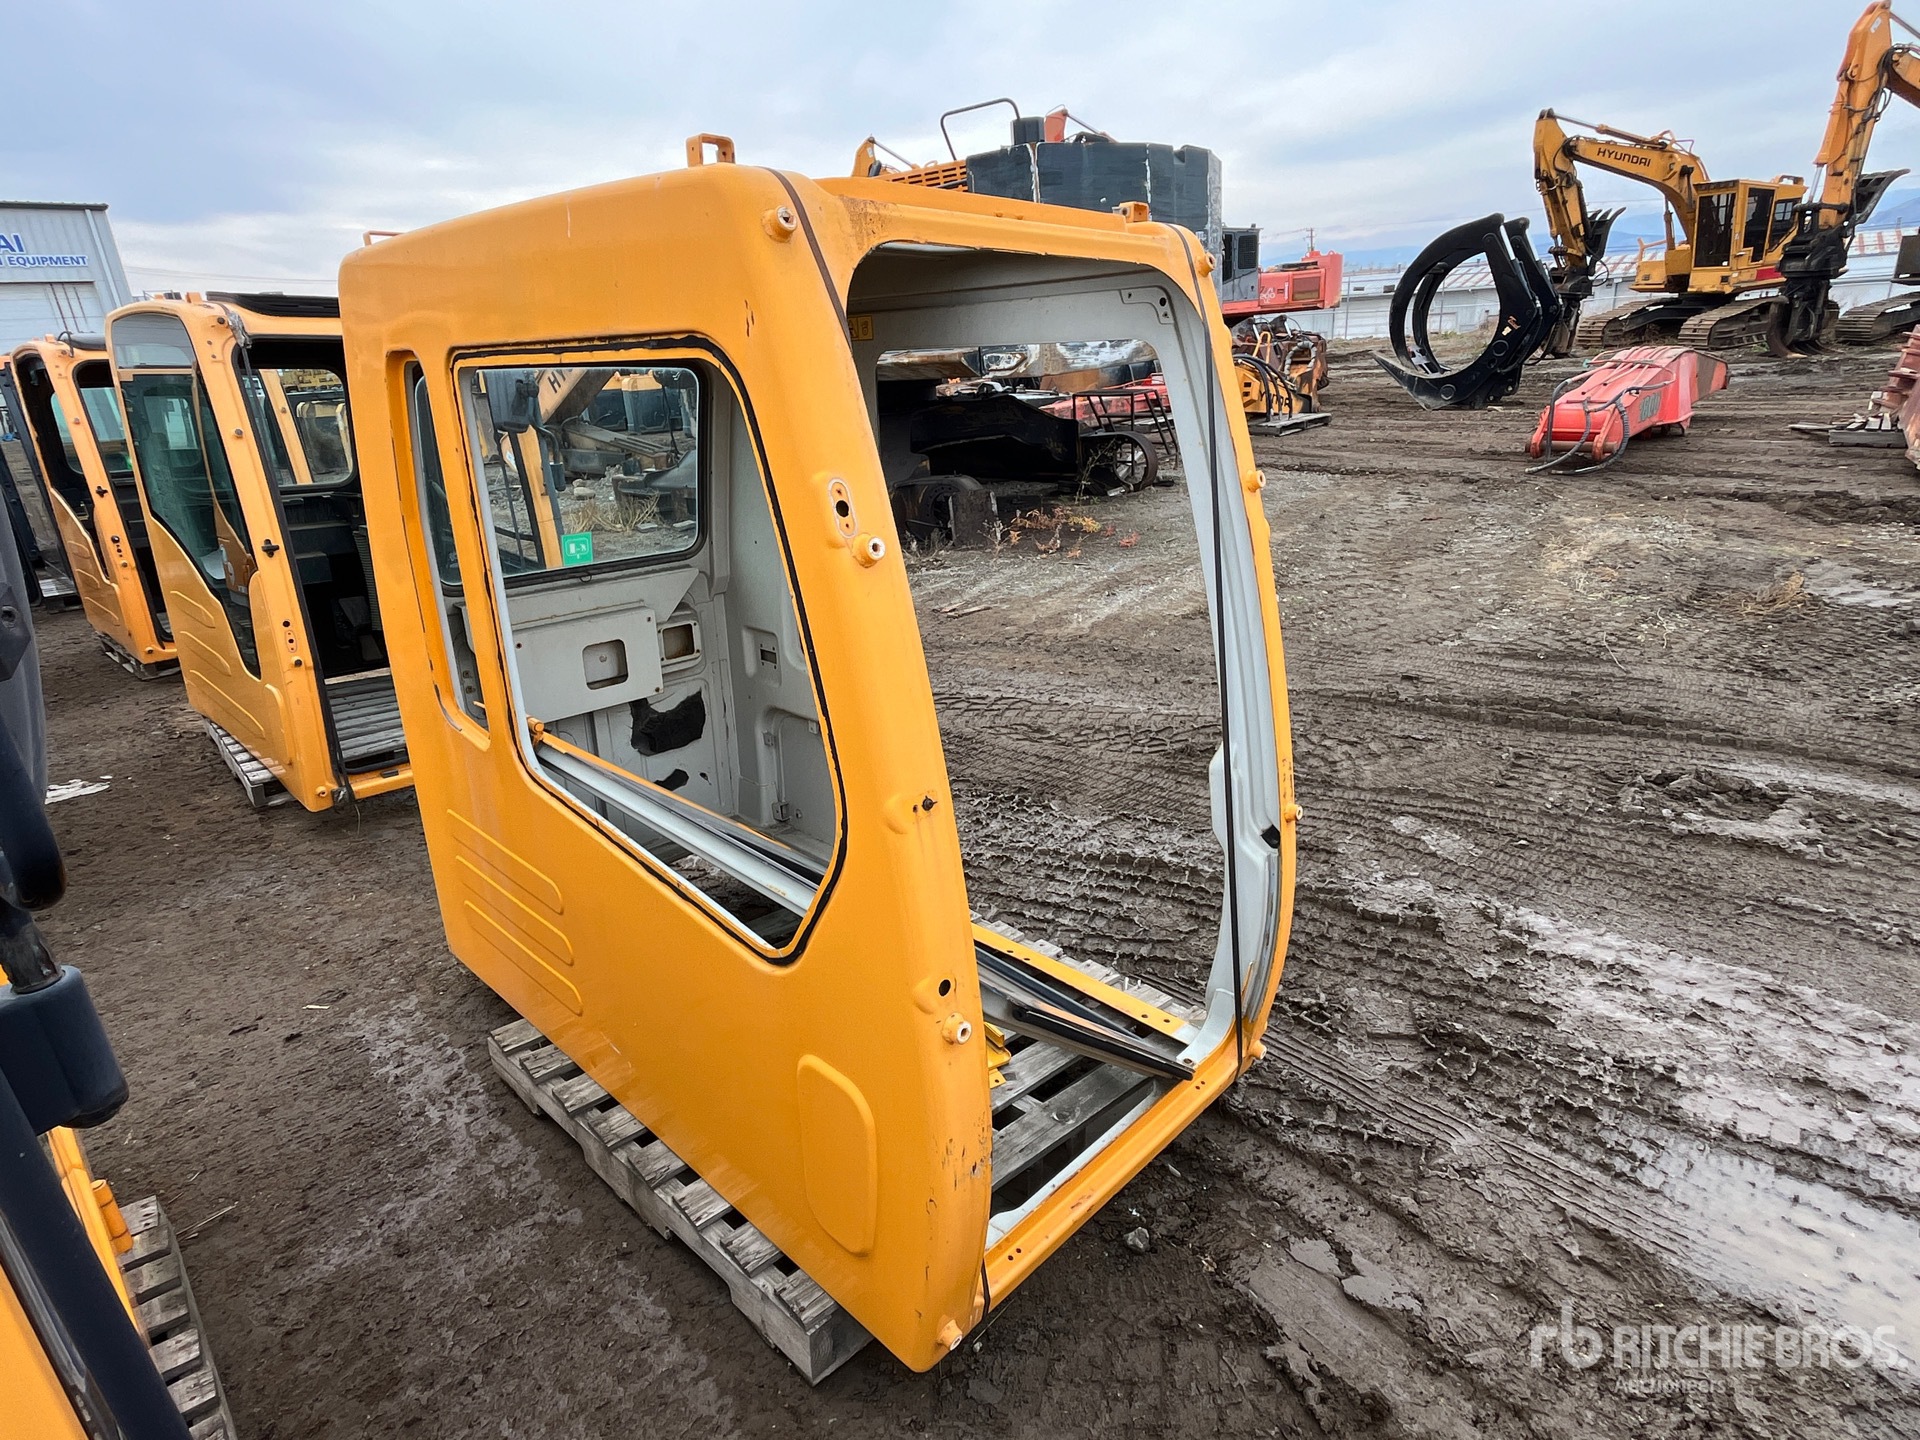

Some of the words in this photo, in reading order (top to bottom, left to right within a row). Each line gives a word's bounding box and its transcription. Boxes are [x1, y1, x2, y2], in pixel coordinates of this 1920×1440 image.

[1597, 147, 1652, 167] HYUNDAI
[7, 256, 87, 267] EQUIPMENT
[547, 368, 574, 394] HY
